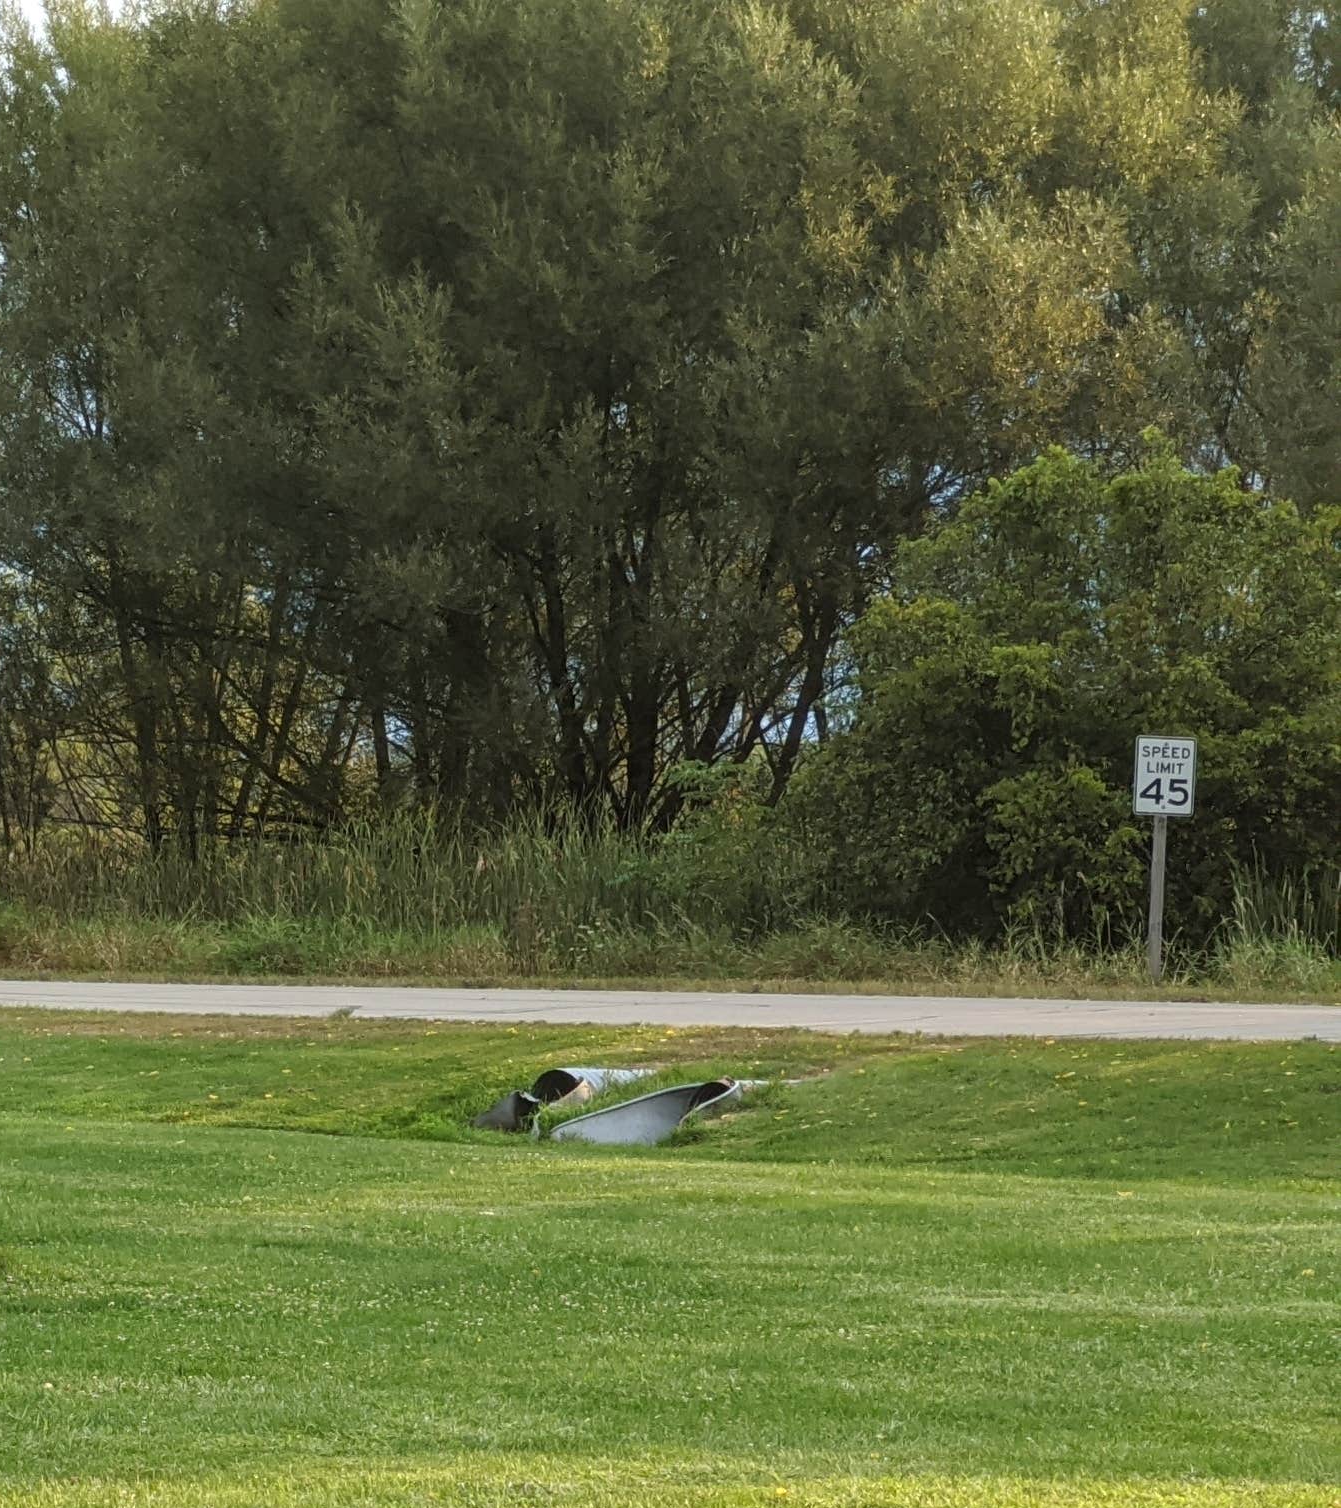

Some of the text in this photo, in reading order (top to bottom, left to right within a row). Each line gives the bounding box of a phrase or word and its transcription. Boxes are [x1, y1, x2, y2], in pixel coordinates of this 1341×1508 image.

[1142, 745, 1191, 760] SPEED
[1146, 761, 1185, 775] LIMIT
[1139, 777, 1189, 807] 45
